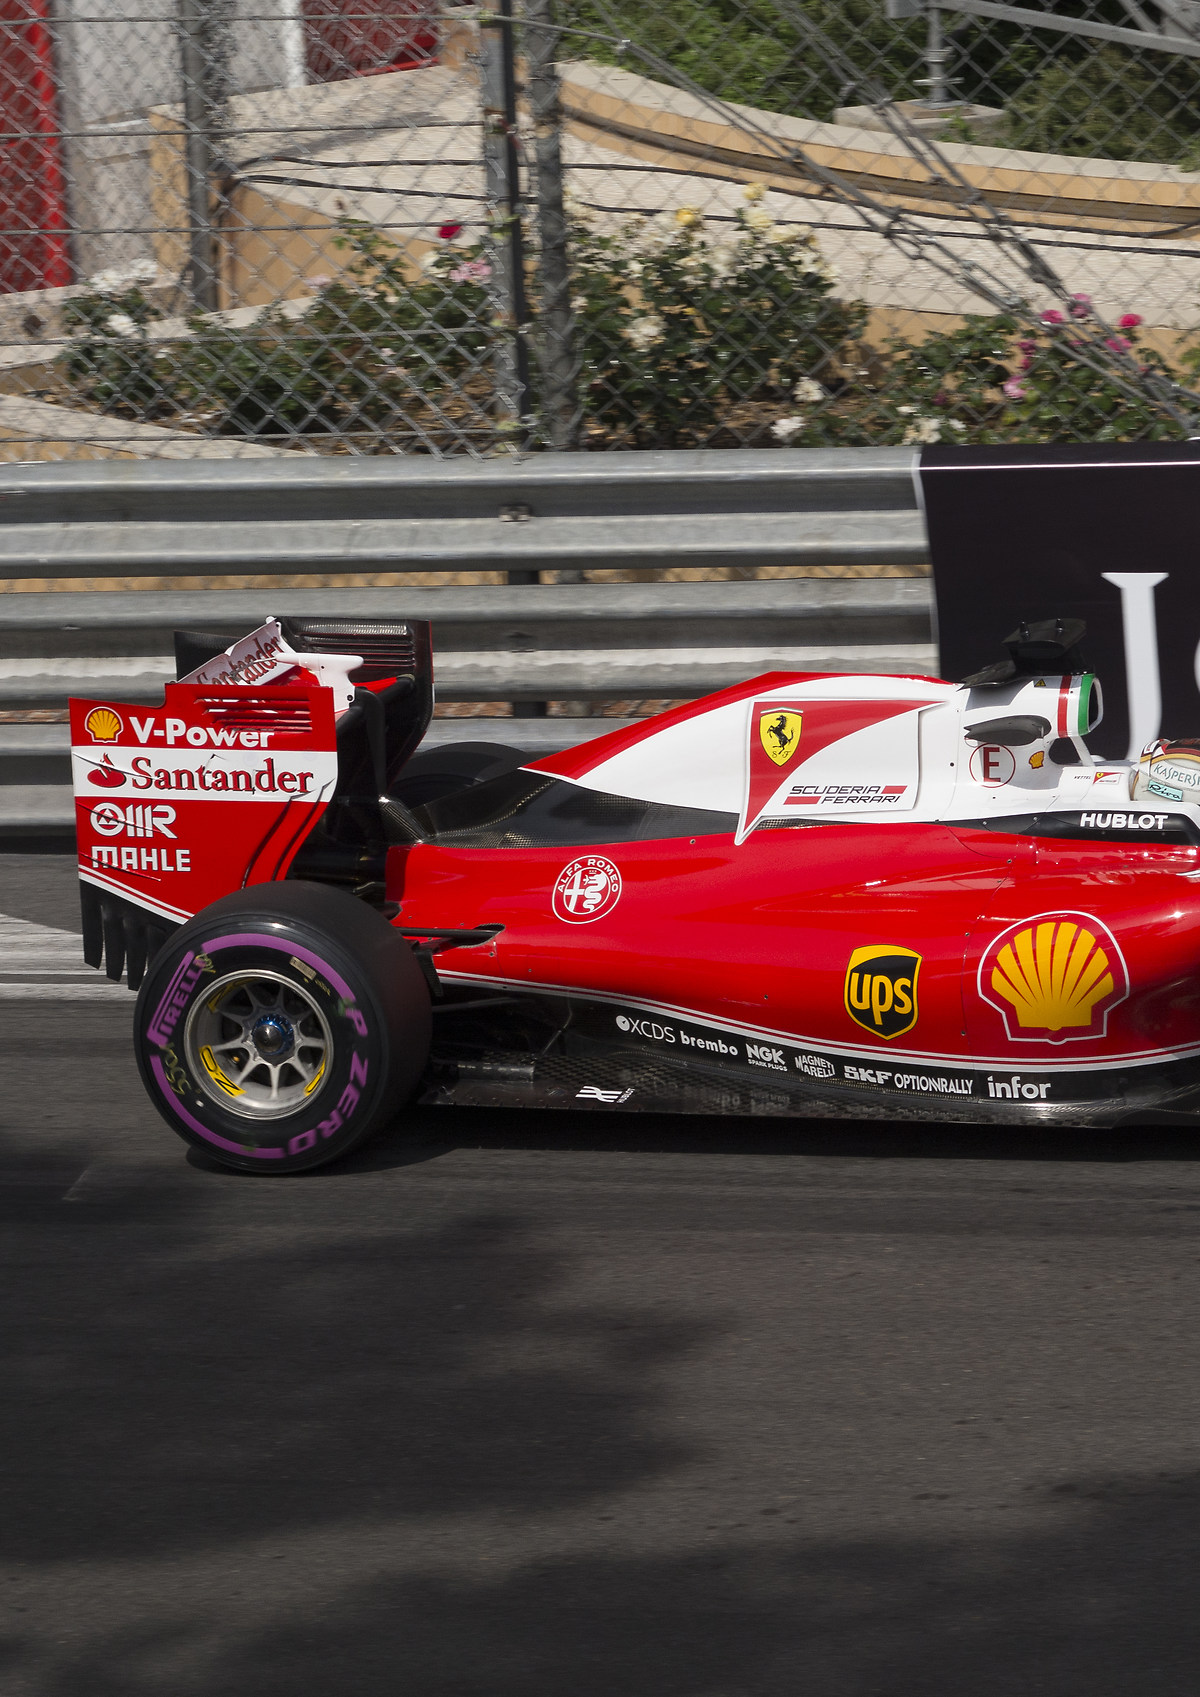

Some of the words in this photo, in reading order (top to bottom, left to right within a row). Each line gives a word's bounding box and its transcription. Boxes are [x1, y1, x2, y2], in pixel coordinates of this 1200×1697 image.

[129, 716, 275, 748] V-Power
[131, 756, 314, 793] Santander
[984, 746, 1001, 782] E
[790, 785, 882, 794] SCUDERIA
[821, 796, 901, 804] FERRARI
[1080, 813, 1168, 830] HUBLOT
[91, 846, 191, 873] MAHLE
[558, 863, 582, 893] ALFA
[587, 858, 619, 893] ROMEO
[146, 950, 207, 1047] PIRELLI
[850, 972, 913, 1026] ups
[680, 1030, 739, 1056] brembo
[745, 1043, 786, 1065] NGK
[747, 1058, 767, 1068] SPARK
[768, 1062, 788, 1072] PLUGS
[844, 1065, 893, 1085] SKF
[987, 1075, 1052, 1098] infor
[288, 1051, 369, 1155] ZERO
